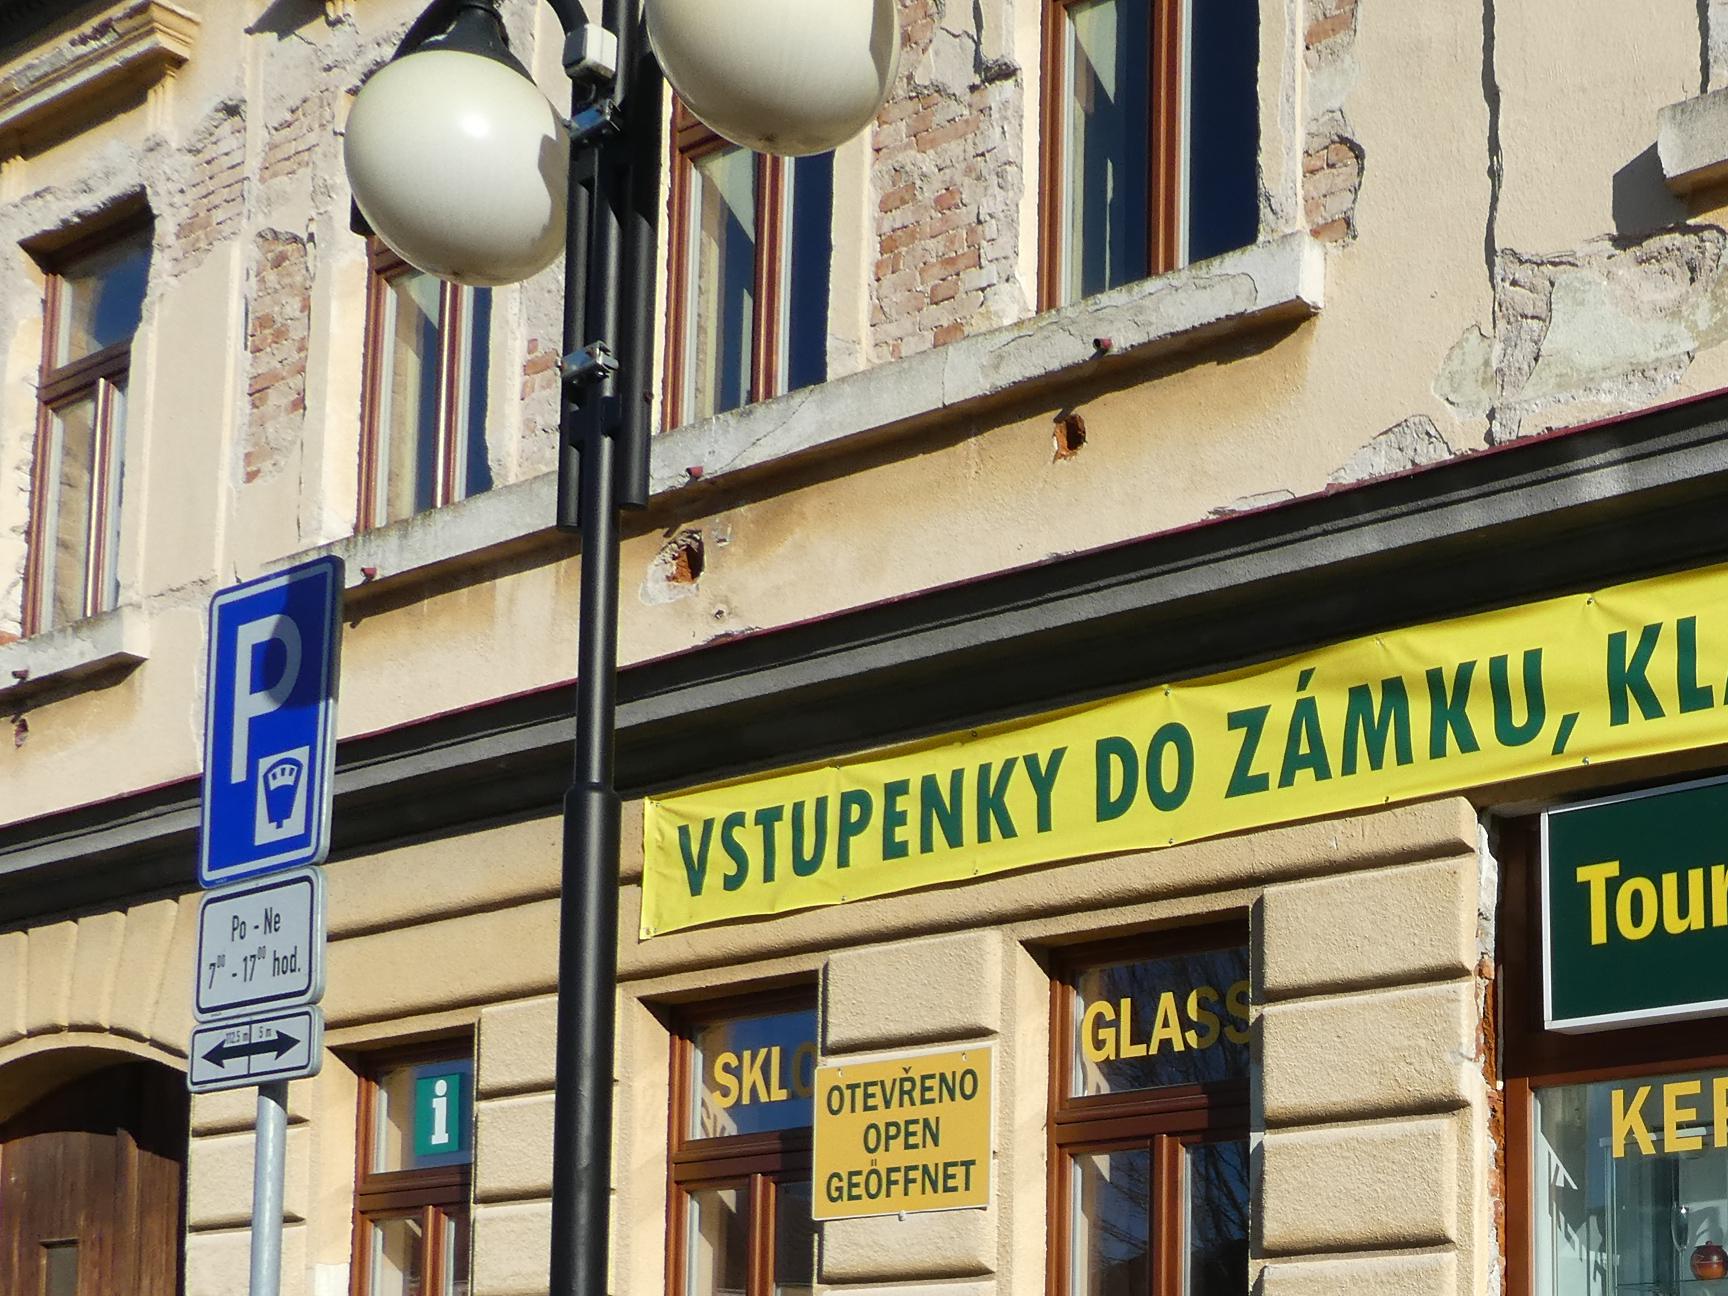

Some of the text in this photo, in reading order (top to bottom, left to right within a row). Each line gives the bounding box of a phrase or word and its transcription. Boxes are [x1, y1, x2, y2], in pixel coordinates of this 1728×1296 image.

[230, 614, 302, 785] P
[678, 746, 1069, 897] VSTUPENKY
[1096, 722, 1194, 822] DO
[1225, 648, 1580, 798] ZÁMKU,
[232, 914, 247, 942] Po
[264, 907, 281, 935] Ne
[272, 945, 301, 977] hod.
[1081, 980, 1250, 1063] GLASS
[826, 1066, 979, 1116] OTEVŘENO
[863, 1116, 941, 1154] OPEN
[825, 1158, 977, 1203] GEÖFFNET
